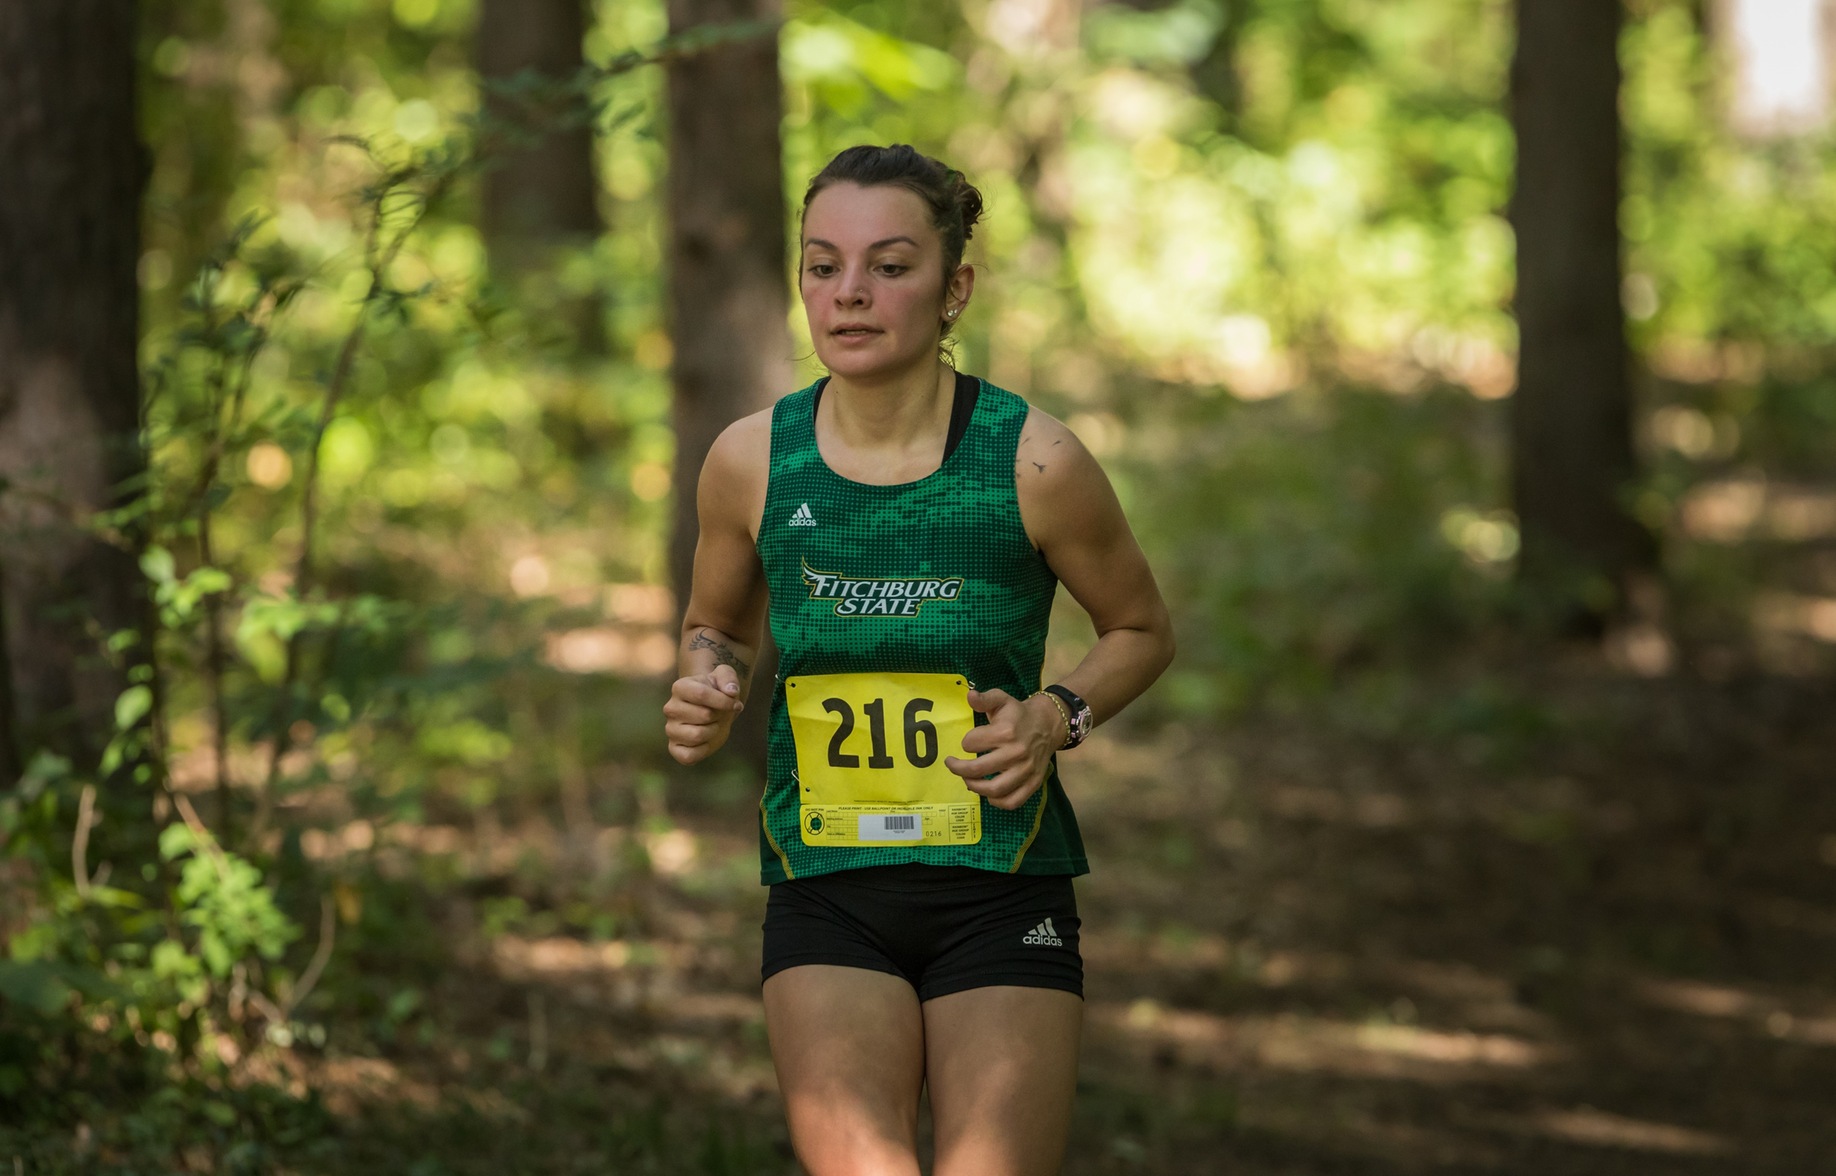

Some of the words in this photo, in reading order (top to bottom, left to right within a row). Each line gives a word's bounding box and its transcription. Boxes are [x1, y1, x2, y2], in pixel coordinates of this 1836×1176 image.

[788, 518, 817, 527] adidas
[803, 566, 960, 599] FITCHBURG
[836, 598, 921, 615] STATE
[821, 697, 939, 769] 216
[1022, 934, 1063, 947] adidas
